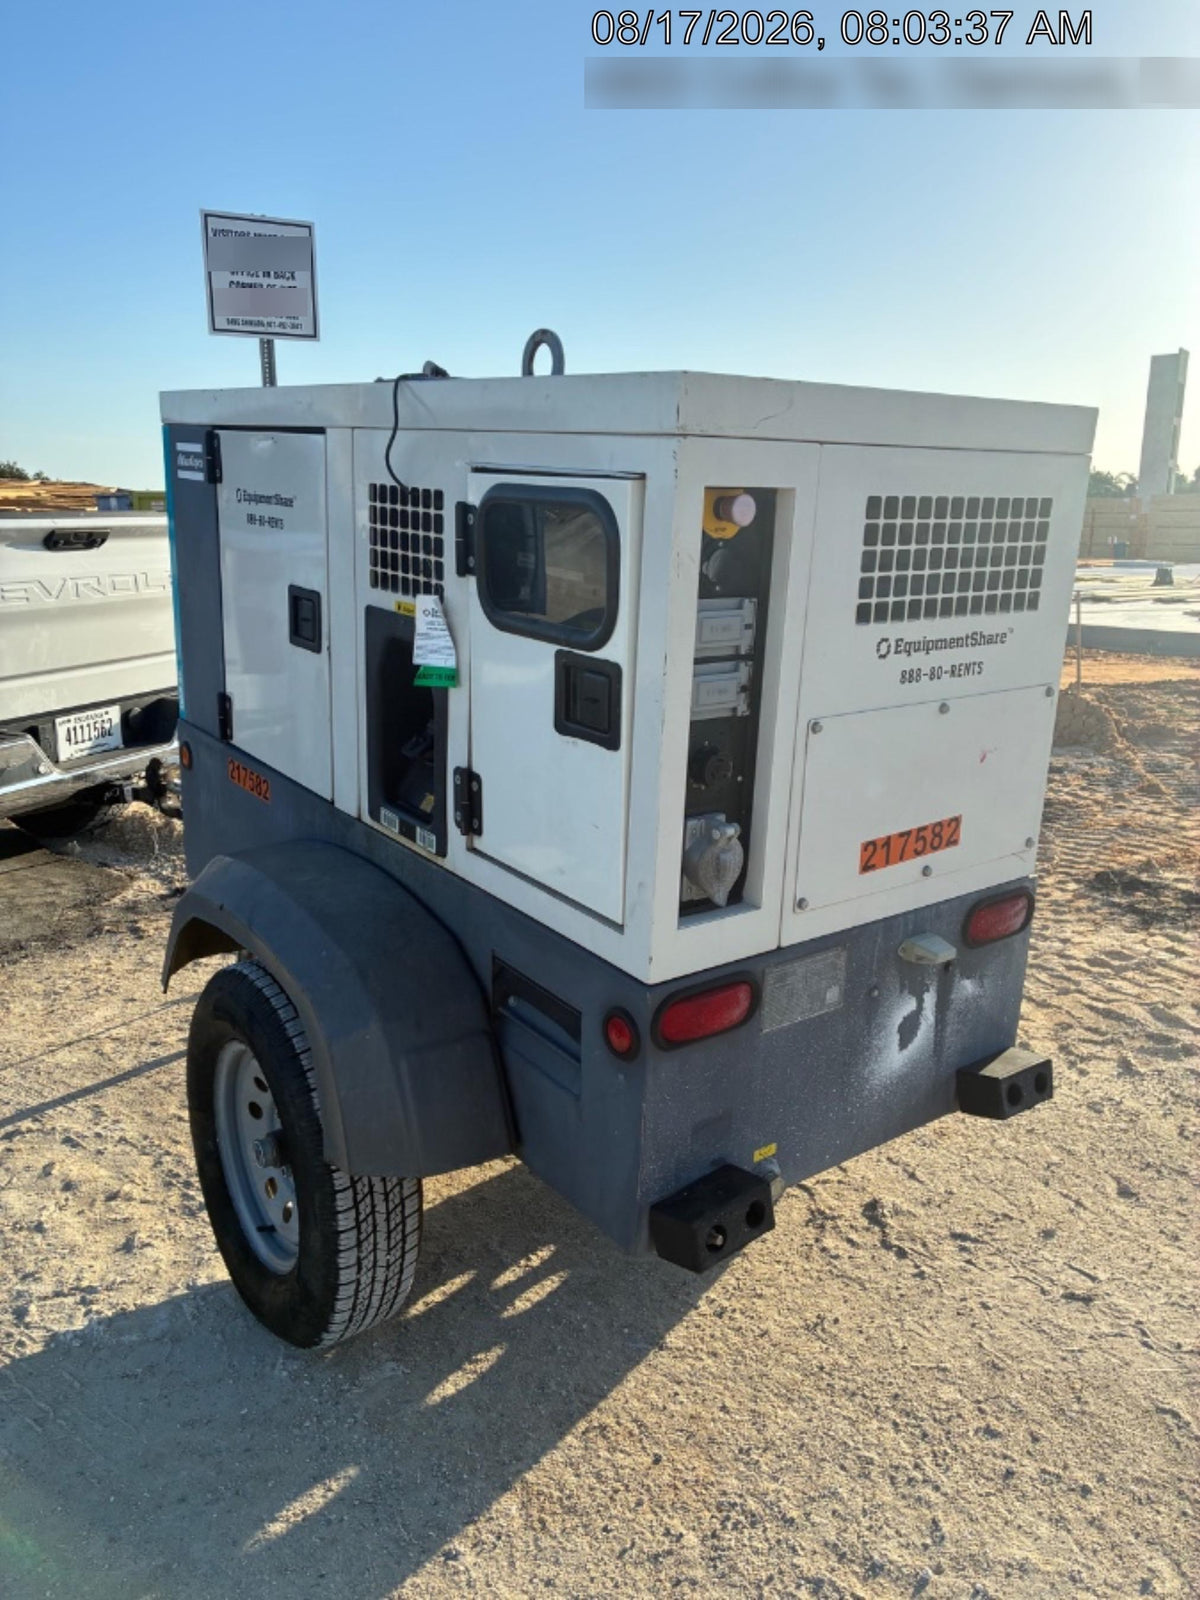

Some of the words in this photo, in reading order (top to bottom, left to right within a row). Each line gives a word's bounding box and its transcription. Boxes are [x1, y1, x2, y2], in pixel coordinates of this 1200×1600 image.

[0, 571, 172, 605] EVROL
[893, 629, 1009, 657] EquipmentShare
[899, 660, 985, 685] 888-80-RENTS
[228, 759, 270, 802] 217582
[861, 814, 961, 873] 217582
